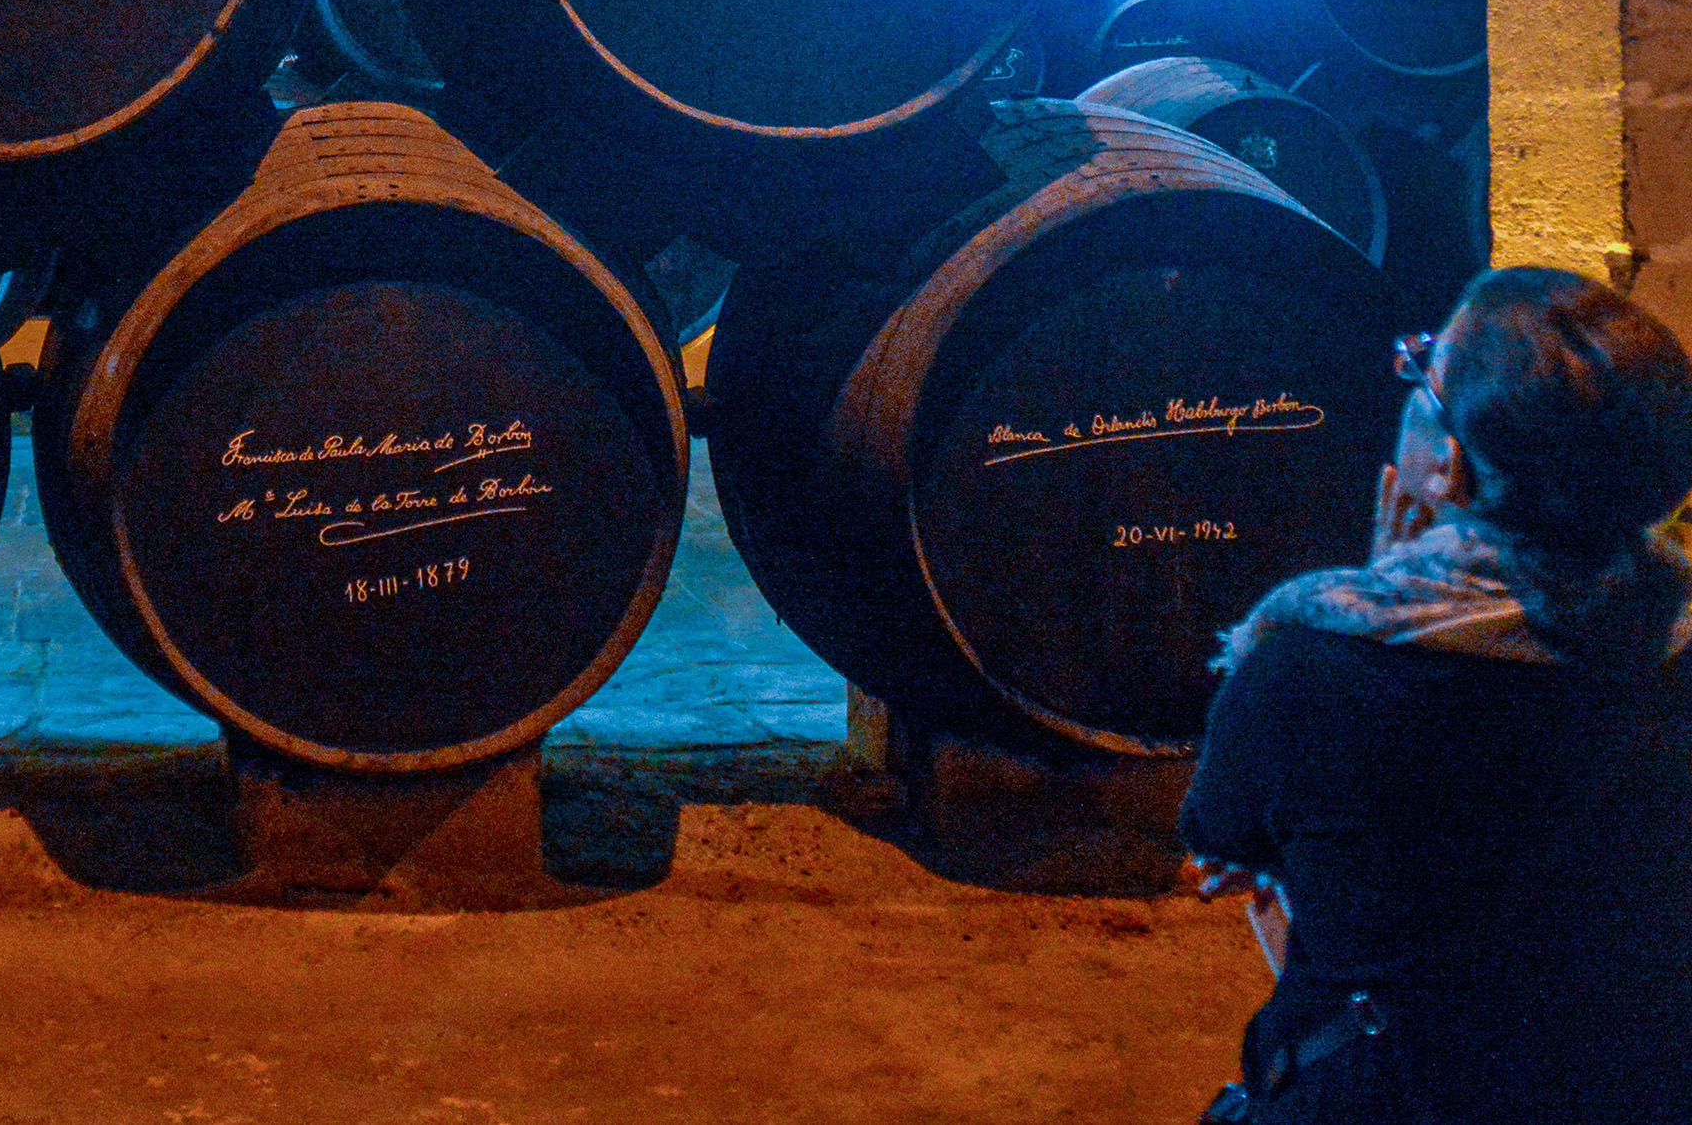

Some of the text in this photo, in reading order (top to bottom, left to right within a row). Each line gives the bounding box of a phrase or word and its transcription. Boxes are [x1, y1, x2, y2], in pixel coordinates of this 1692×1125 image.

[1063, 422, 1082, 438] de
[298, 445, 314, 462] de
[317, 435, 363, 459] Paula
[433, 432, 454, 450] de
[275, 489, 332, 518] Luisa
[345, 497, 363, 514] de
[371, 493, 393, 511] la
[395, 490, 438, 511] Torre
[449, 487, 469, 504] de
